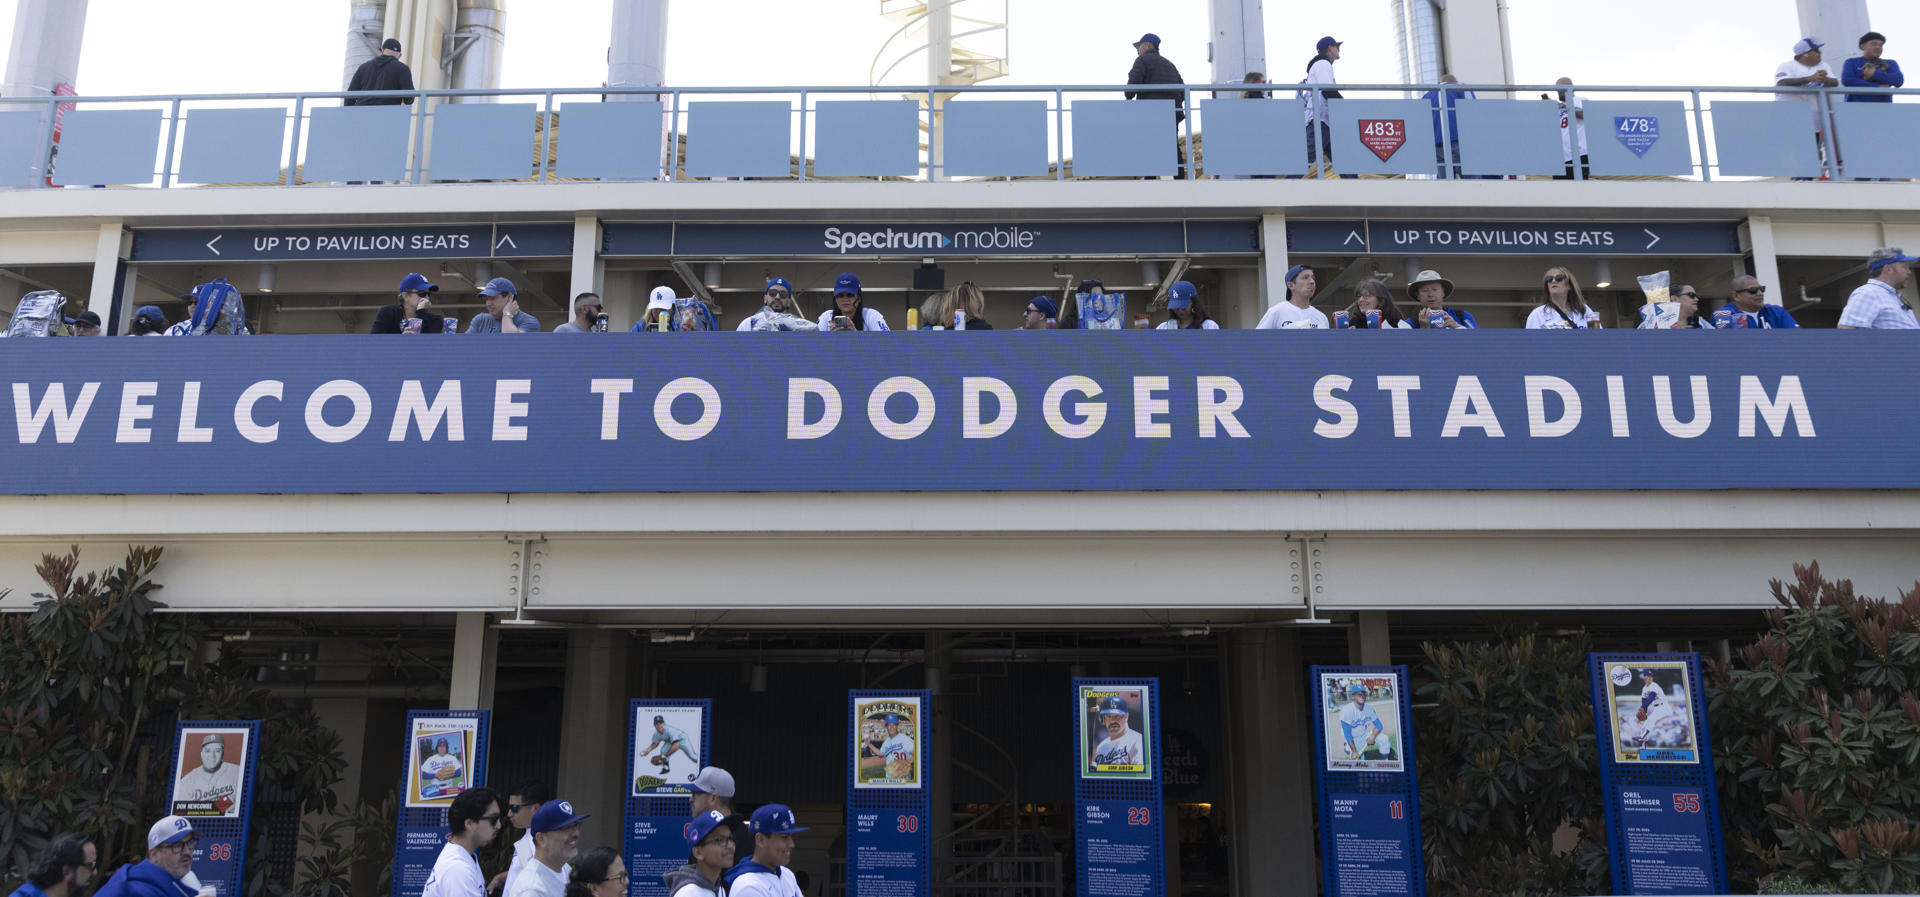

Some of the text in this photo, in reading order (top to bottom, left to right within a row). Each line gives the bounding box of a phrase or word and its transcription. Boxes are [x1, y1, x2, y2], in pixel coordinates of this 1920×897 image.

[1364, 122, 1395, 136] 483
[1620, 118, 1649, 132] 478
[253, 234, 470, 250] UP TO PAVILION SEATS
[824, 227, 943, 254] Spectrum
[1394, 230, 1614, 246] UP TO PAVILION SEATS
[12, 374, 1817, 444] WELCOME TO DODGER STADIUM
[1086, 690, 1119, 698] DODGERS
[863, 703, 914, 717] DODGERS
[192, 784, 234, 801] Dodgers
[1390, 800, 1403, 819] 11
[1672, 793, 1700, 813] 55
[897, 815, 918, 832] 30
[1128, 807, 1150, 825] 23
[210, 843, 232, 860] 36
